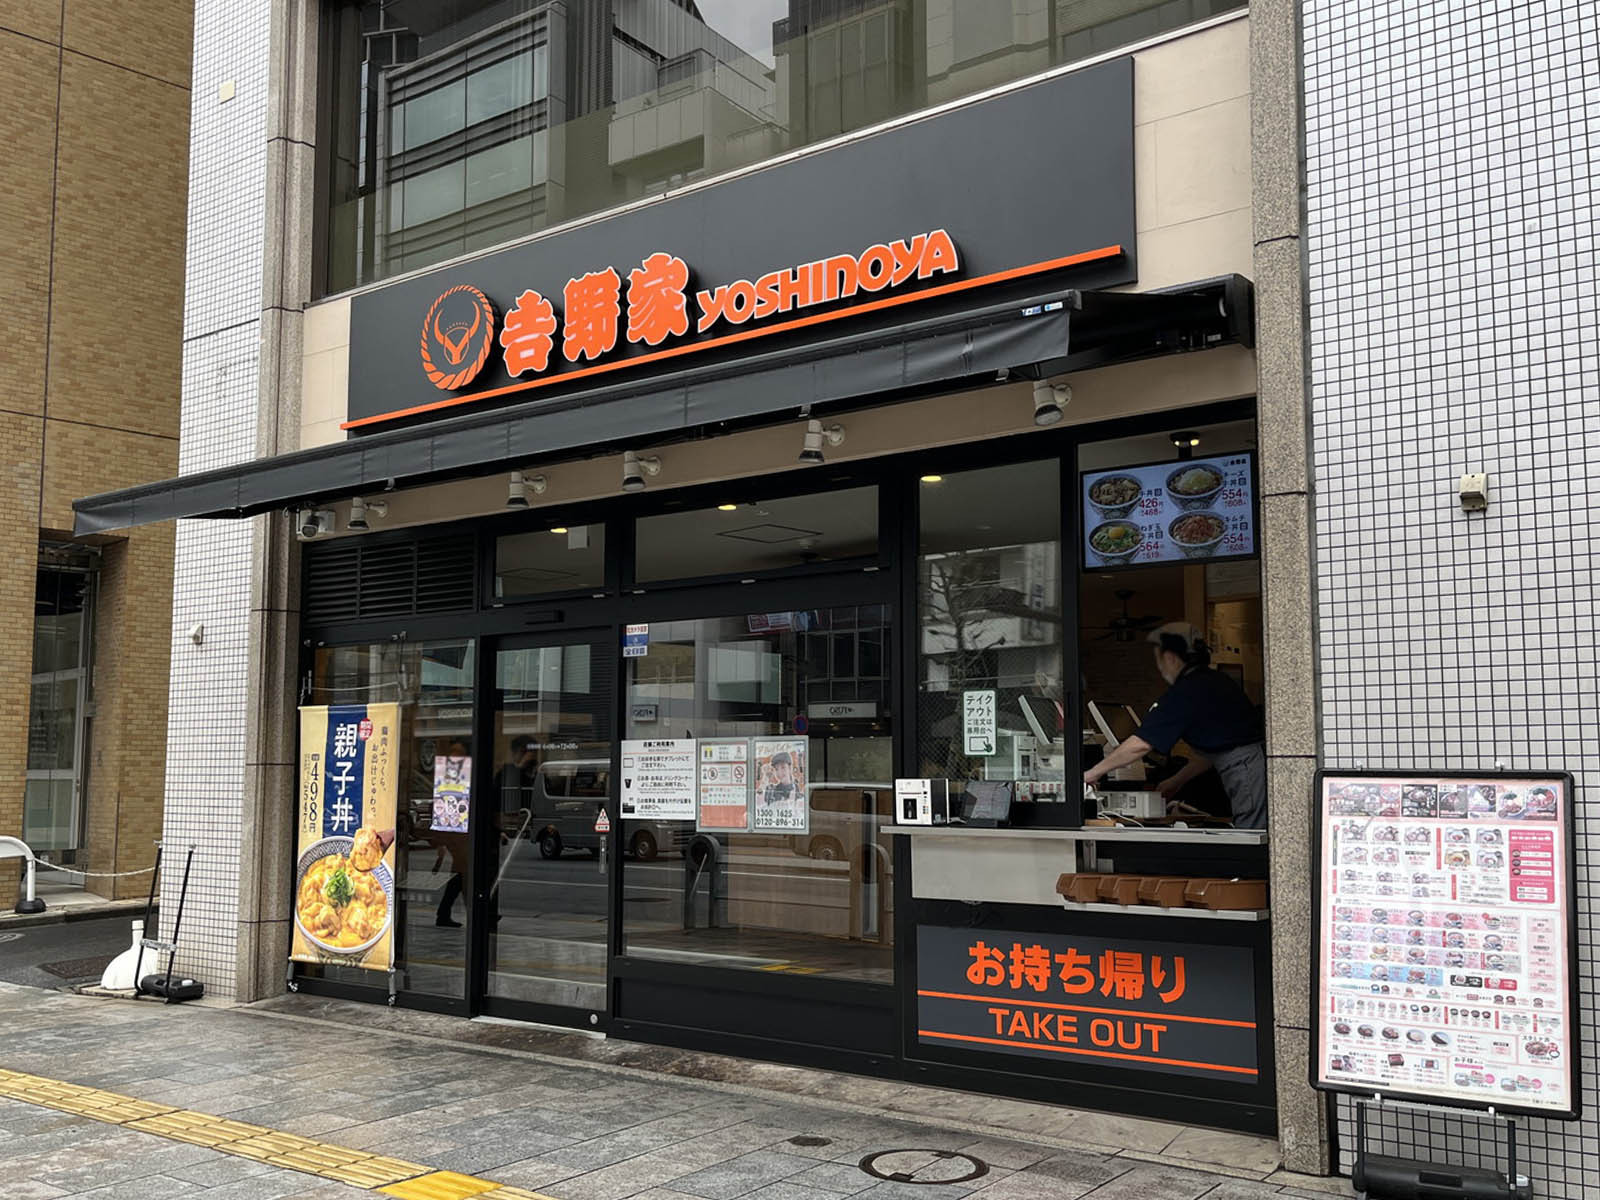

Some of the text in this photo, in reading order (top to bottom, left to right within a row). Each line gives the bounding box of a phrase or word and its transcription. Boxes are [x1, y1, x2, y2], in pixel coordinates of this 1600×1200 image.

[500, 252, 688, 378] 吉野家
[967, 694, 992, 705] テイク
[967, 706, 992, 717] アウト
[967, 718, 992, 726] ご注文は
[331, 723, 358, 832] 親子丼
[966, 941, 1187, 1004] お持ち帰り
[988, 1008, 1168, 1052] TAKE OUT
